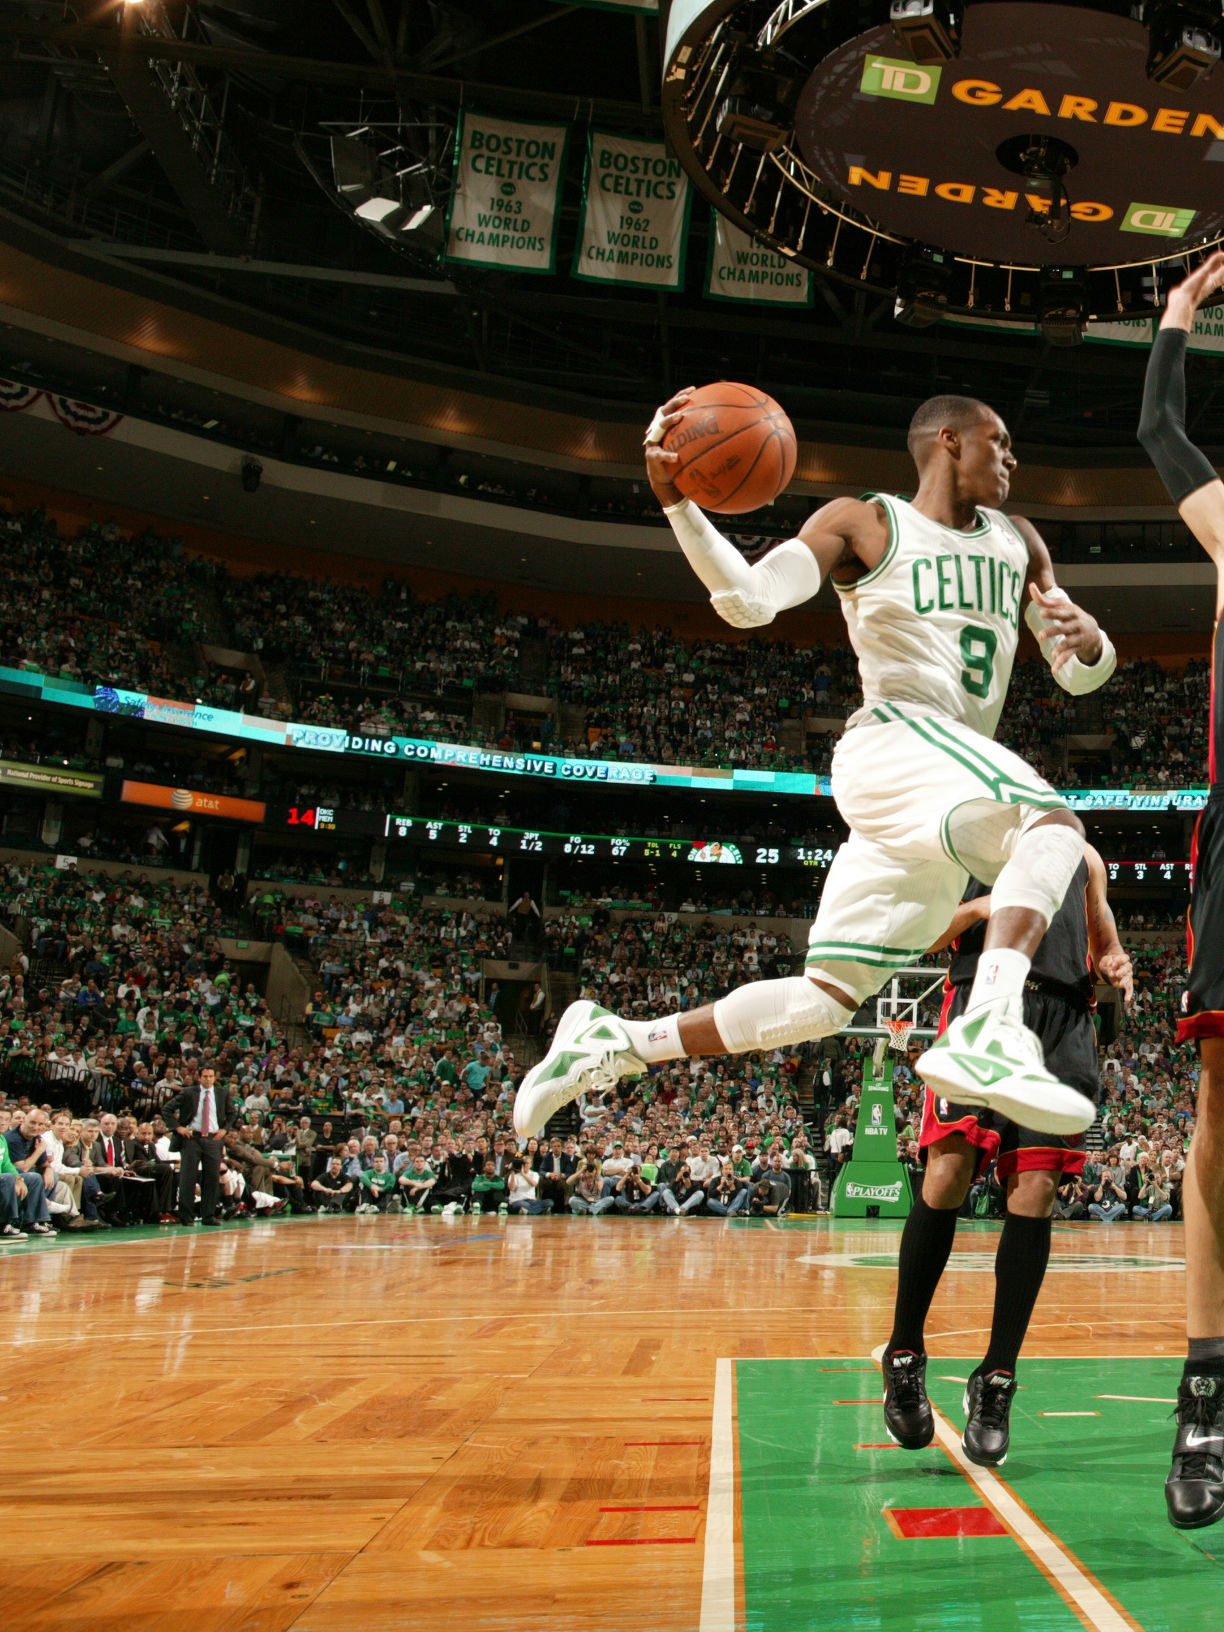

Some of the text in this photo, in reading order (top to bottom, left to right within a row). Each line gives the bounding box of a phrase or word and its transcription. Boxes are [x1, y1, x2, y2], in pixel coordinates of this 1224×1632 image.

[871, 62, 932, 95] TD
[469, 129, 556, 161] BOSTON
[470, 154, 550, 183] CELTICS
[600, 149, 682, 180] BOSTON
[600, 173, 677, 200] CELTICS
[490, 197, 522, 215] 1963
[477, 213, 531, 233] WORLD
[618, 216, 650, 233] 1962
[455, 227, 545, 252] CHAMPIONS
[606, 230, 659, 251] WORLD
[586, 245, 673, 270] CHAMPIONS
[736, 250, 787, 269] WORLD
[718, 265, 803, 287] CHAMPIONS
[912, 554, 1021, 630] CELTICS
[959, 624, 998, 699] 9
[124, 695, 158, 714] Safety
[158, 703, 215, 723] Insurance
[291, 728, 657, 783] PROVIDING COMPREHENSIVE COVERAGE
[287, 807, 316, 825] 14
[395, 817, 630, 848] REB AST STL TO 3PT FG FG%
[428, 829, 438, 840] 5
[458, 834, 468, 843] 2
[488, 836, 498, 847] 4
[520, 839, 543, 851] 1/2
[563, 843, 595, 855] 8/12
[611, 846, 627, 856] 67
[671, 850, 677, 858] 4
[755, 848, 780, 864] 25
[797, 848, 834, 861] 1:24
[820, 860, 827, 868] 1
[1109, 870, 1172, 880] 3 3 4
[865, 1127, 888, 1136] NBA TV
[852, 1186, 900, 1198] PLAYOFFS
